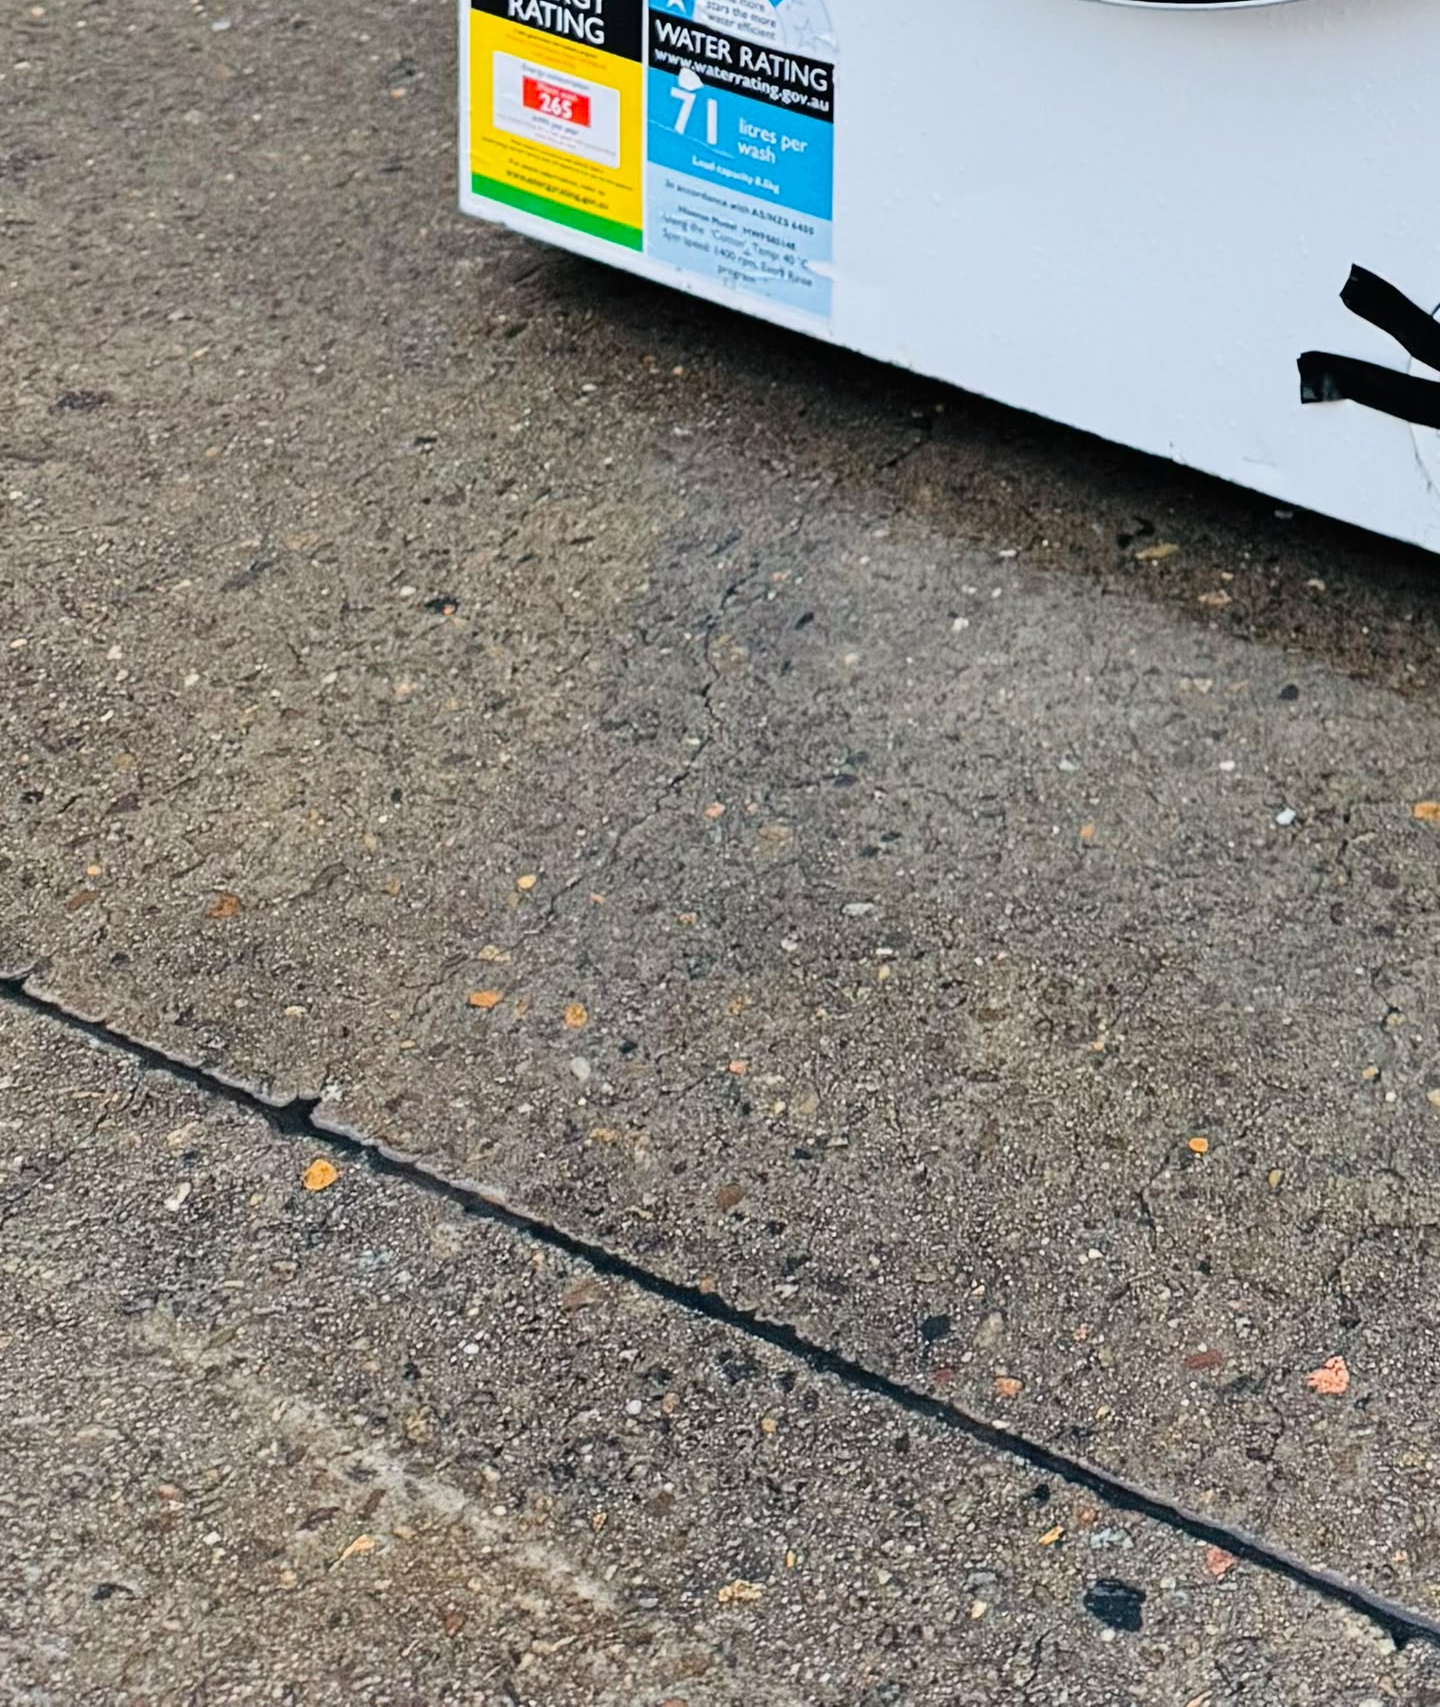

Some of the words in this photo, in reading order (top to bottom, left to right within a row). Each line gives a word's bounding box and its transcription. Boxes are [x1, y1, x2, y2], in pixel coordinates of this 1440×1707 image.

[706, 0, 730, 15] stars
[732, 7, 749, 20] the
[750, 13, 777, 28] more
[654, 18, 734, 65] WATER
[738, 45, 829, 93] RATING
[653, 47, 831, 113] www.waterrating.gov.au
[538, 92, 574, 120] 265
[669, 86, 719, 146] 71
[736, 140, 777, 165] wash
[738, 116, 778, 145] litres
[780, 134, 809, 154] per
